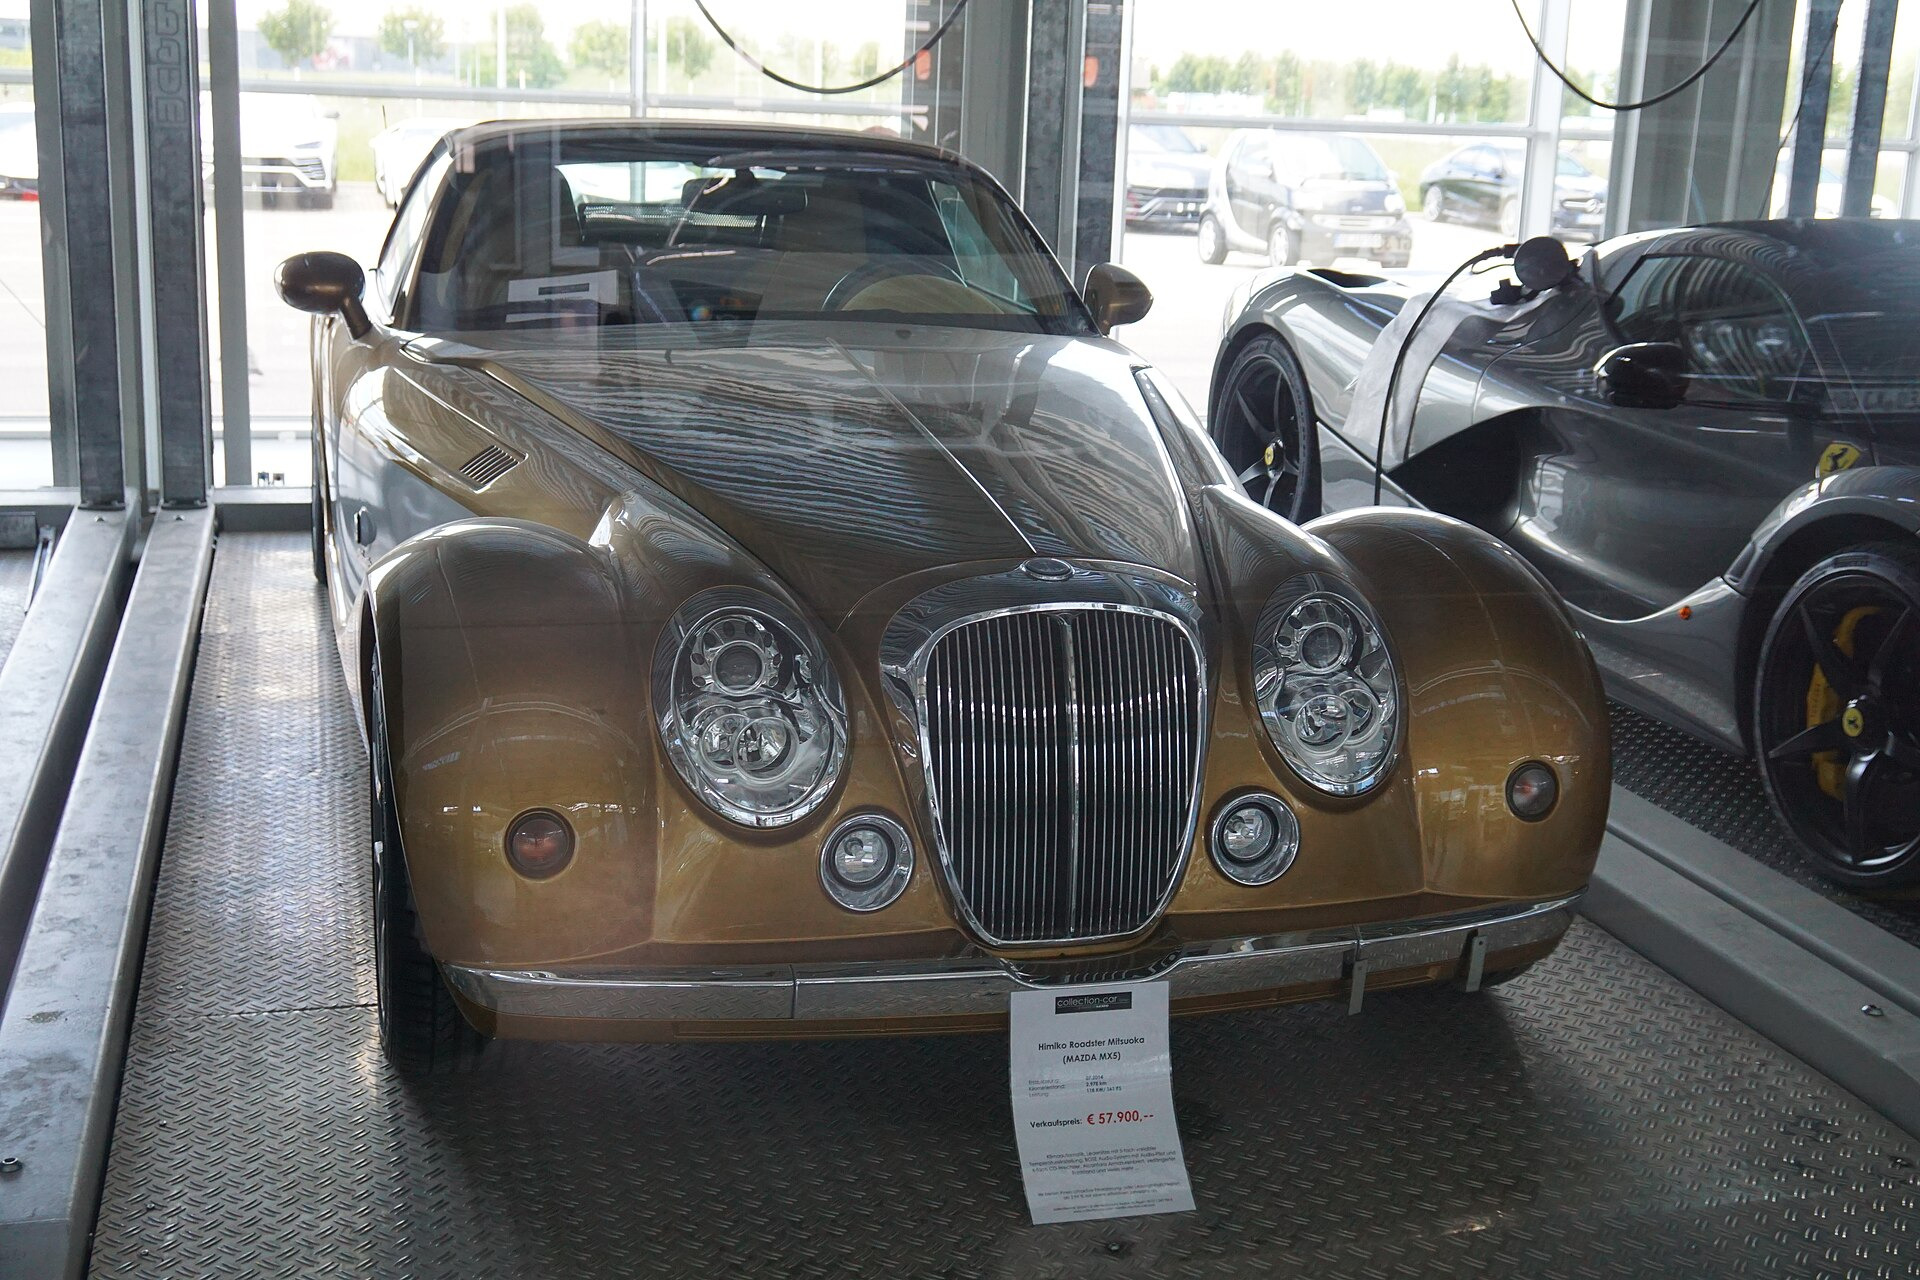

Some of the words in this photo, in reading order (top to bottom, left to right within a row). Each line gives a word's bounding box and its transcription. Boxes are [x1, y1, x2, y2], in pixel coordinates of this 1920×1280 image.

[1057, 996, 1118, 1007] collection-car
[1038, 1042, 1067, 1051] Himiko
[1069, 1039, 1106, 1049] Roadster
[1107, 1036, 1145, 1046] Mitsuoka
[1062, 1053, 1097, 1065] (MAZDA
[1099, 1051, 1121, 1061] MX5)
[1029, 1117, 1083, 1129] Verkaufspreis:
[1087, 1113, 1096, 1125] €
[1098, 1110, 1154, 1124] 57.900,--
